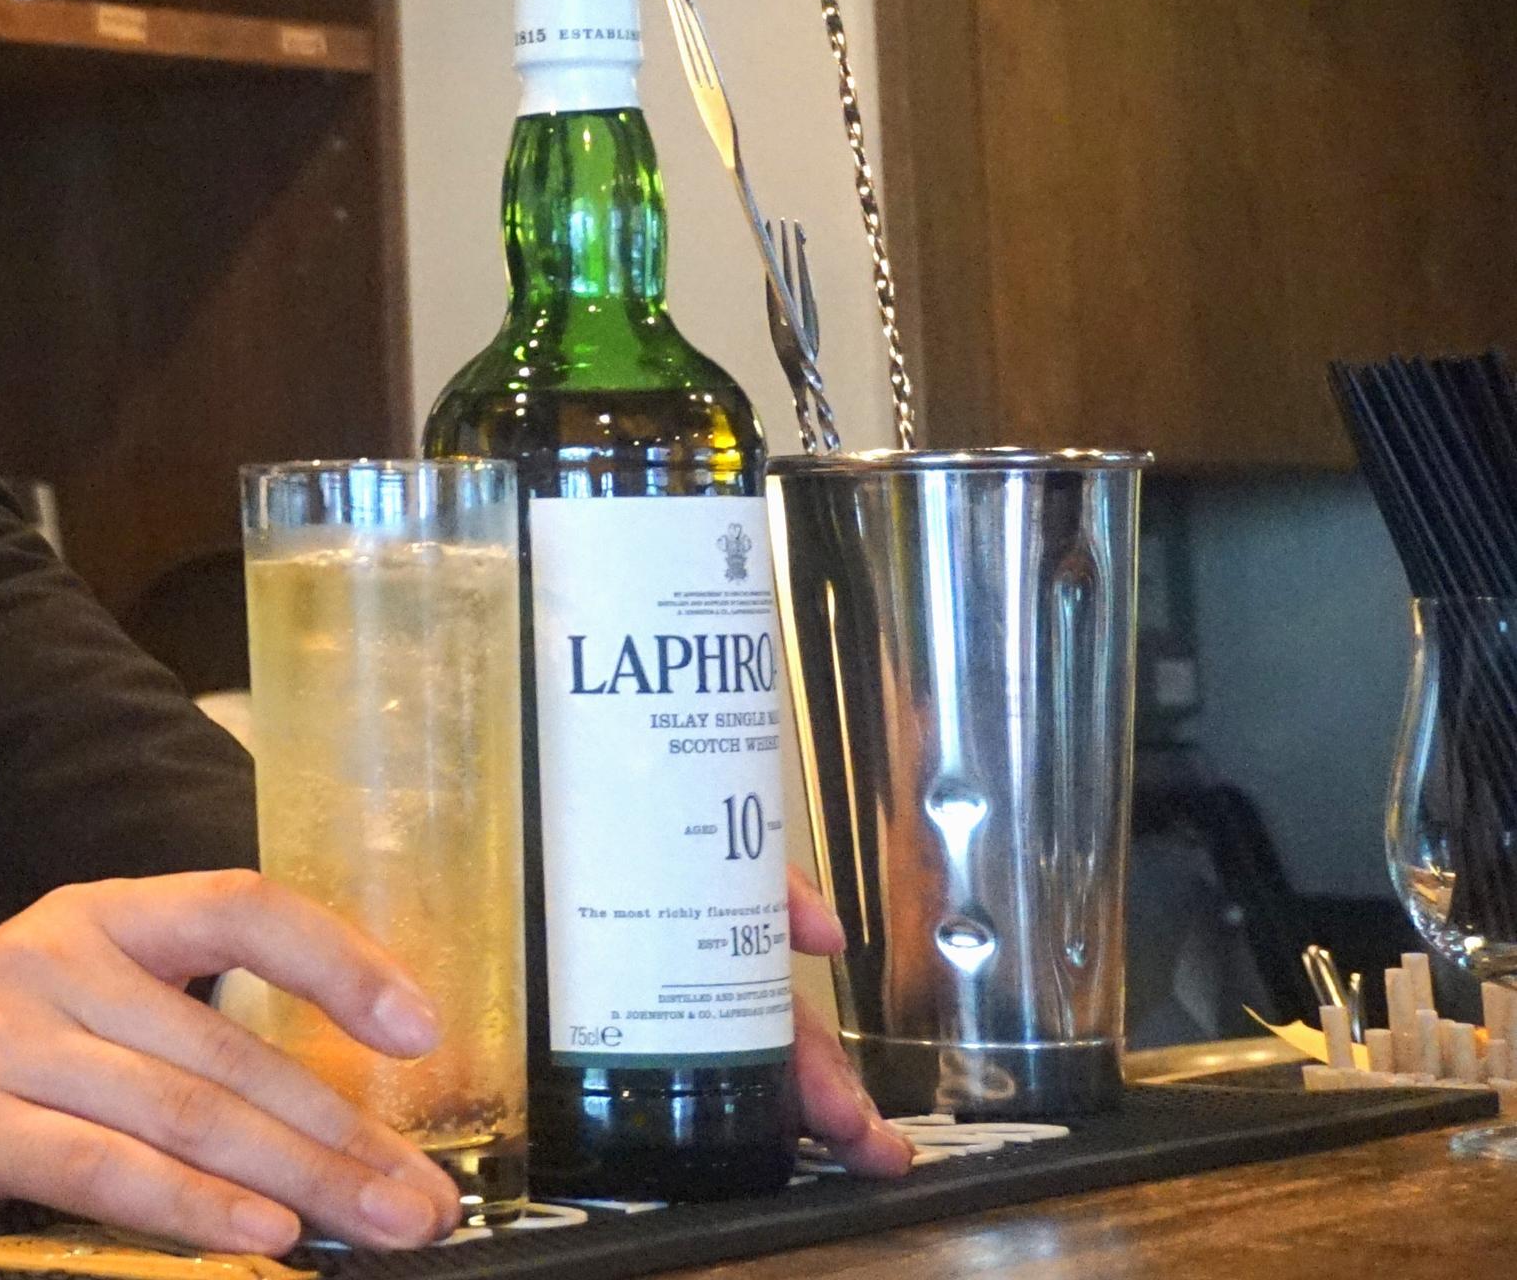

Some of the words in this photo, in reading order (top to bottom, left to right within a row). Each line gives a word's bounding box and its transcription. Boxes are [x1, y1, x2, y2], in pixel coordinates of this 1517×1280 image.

[650, 713, 709, 728] ISLAY
[715, 711, 765, 728] SINGLE
[669, 738, 740, 754] SCOTCH
[723, 792, 764, 860] 10
[578, 906, 607, 918] The
[613, 908, 650, 918] most
[658, 907, 701, 920] richly
[730, 923, 771, 957] 1815
